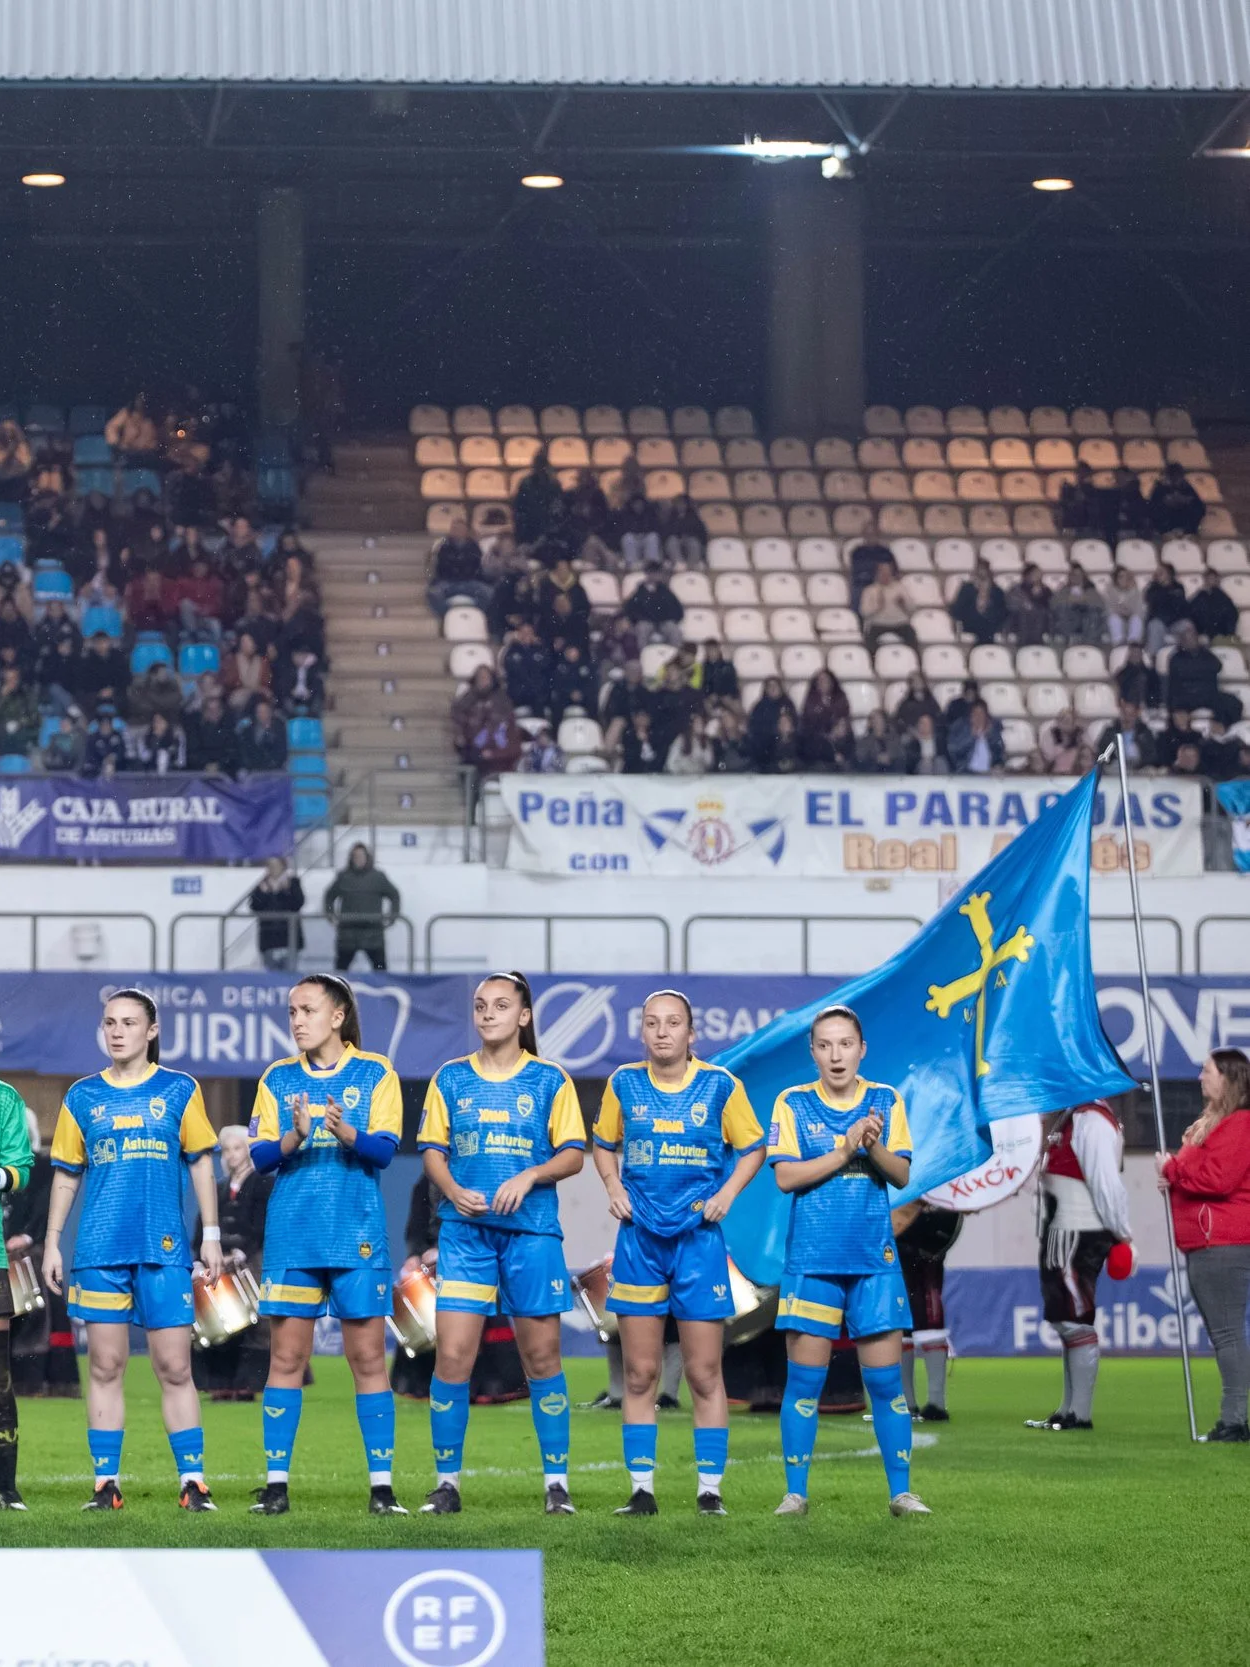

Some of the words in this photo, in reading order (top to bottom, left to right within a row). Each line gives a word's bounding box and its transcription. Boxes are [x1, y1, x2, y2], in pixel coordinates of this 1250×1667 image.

[52, 797, 122, 824] CAJA
[127, 796, 226, 824] RURAL
[518, 790, 626, 828] Peña
[805, 791, 864, 827] EL
[55, 827, 82, 845] DE
[84, 826, 177, 845] ASTURIAS
[568, 851, 629, 872] con
[842, 832, 958, 872] Real
[221, 984, 292, 1009] DENT
[122, 1136, 169, 1153] Asturias
[485, 1131, 534, 1149] Asturias
[659, 1141, 708, 1158] Asturias
[1012, 1302, 1213, 1351] Fetiber
